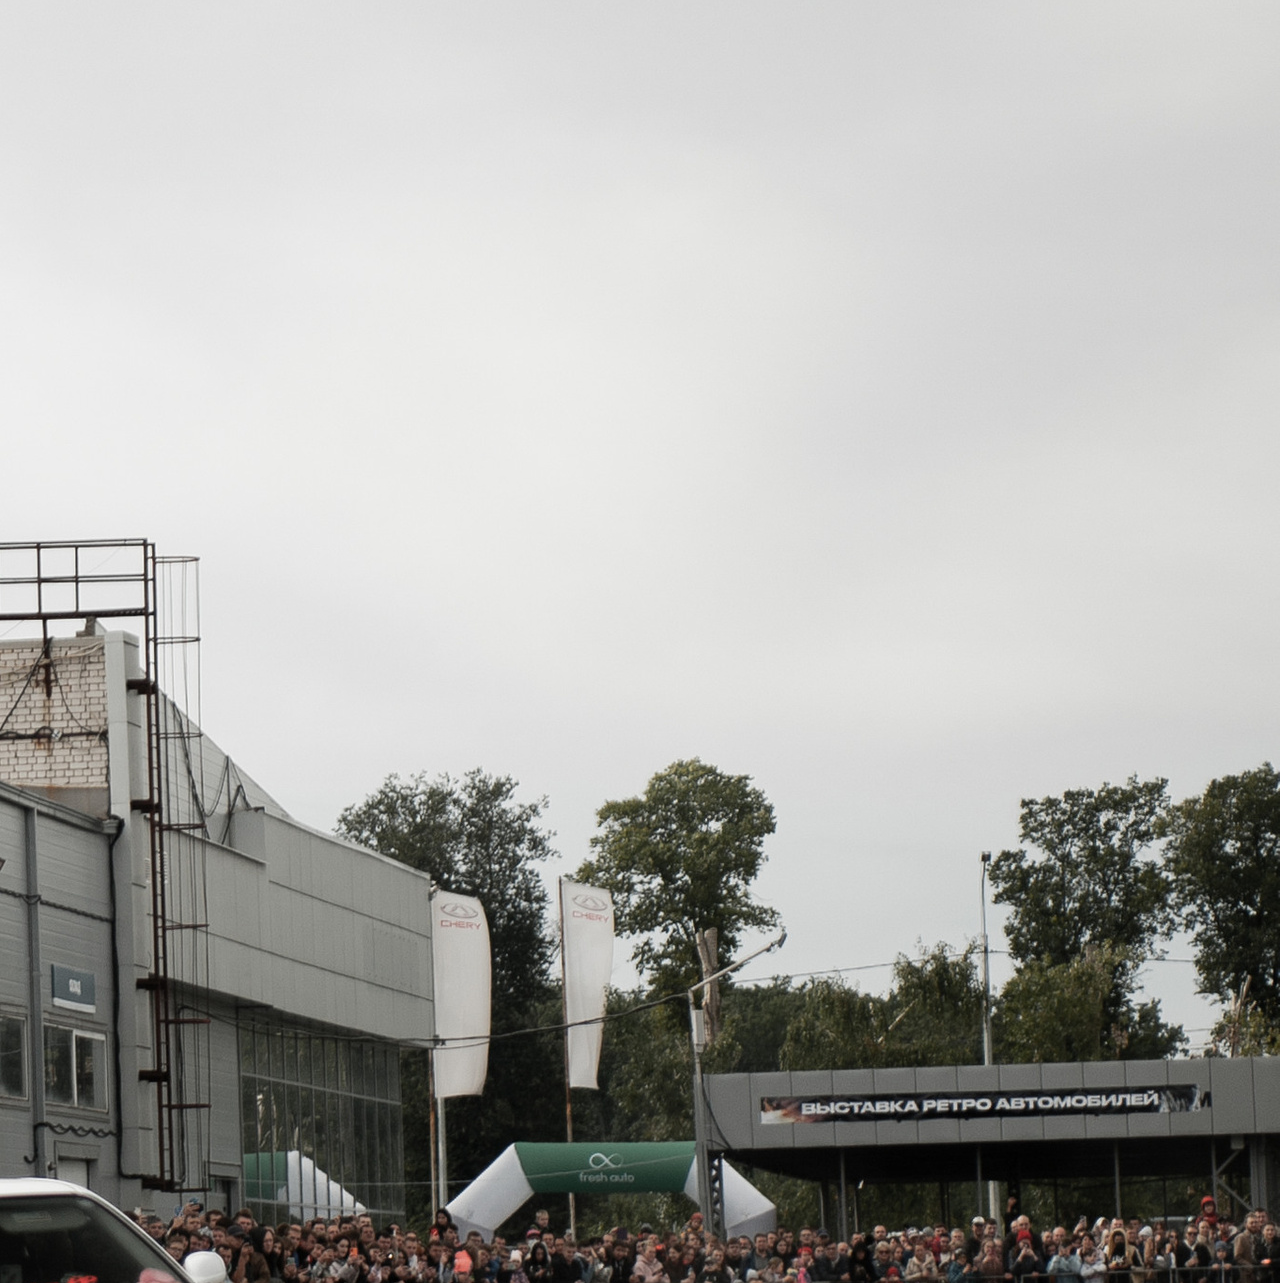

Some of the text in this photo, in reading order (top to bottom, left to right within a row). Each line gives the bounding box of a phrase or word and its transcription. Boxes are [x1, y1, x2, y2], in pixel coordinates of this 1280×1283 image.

[572, 910, 610, 923] CHERY
[440, 919, 482, 930] CHERY
[801, 1090, 1160, 1115] ВЫСТАВКА РЕТРО АВТОМОБИЛЕЙ
[579, 1171, 635, 1183] fresh auto
